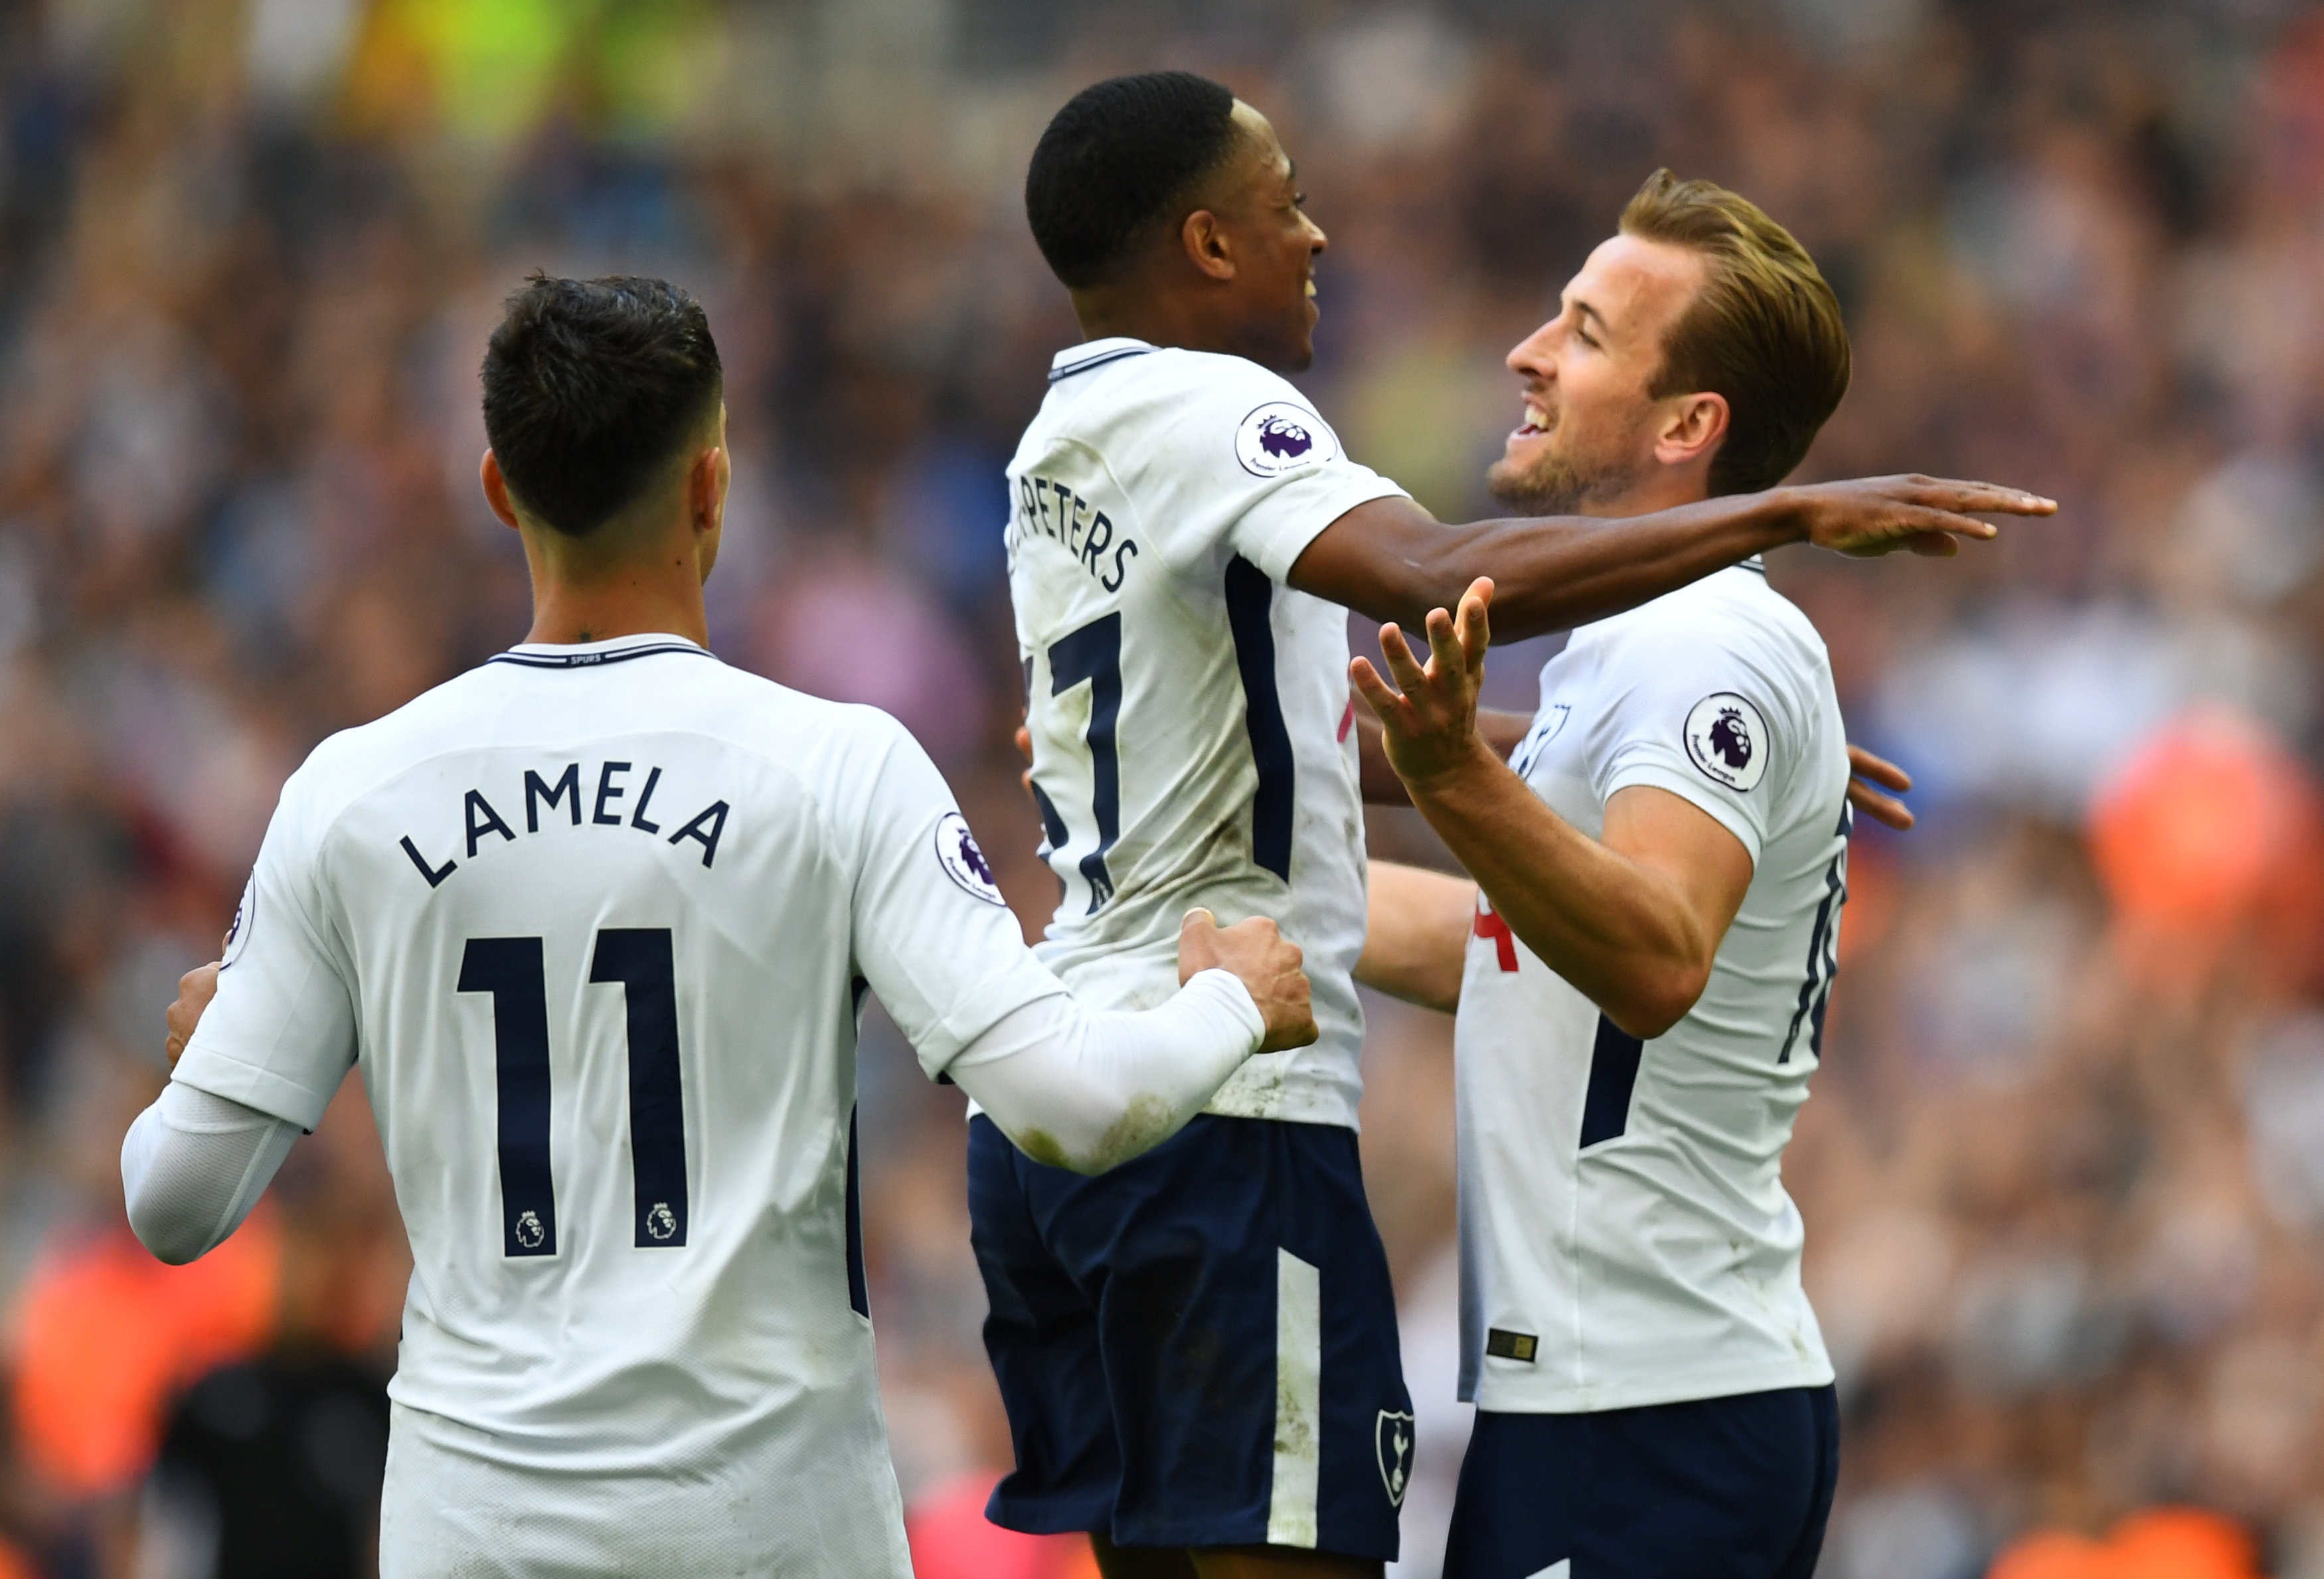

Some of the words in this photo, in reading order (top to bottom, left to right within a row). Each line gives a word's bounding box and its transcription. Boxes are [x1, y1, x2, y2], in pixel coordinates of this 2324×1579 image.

[571, 654, 601, 665] SPURS
[400, 761, 730, 888] LAMELA
[457, 928, 689, 1258] 11
